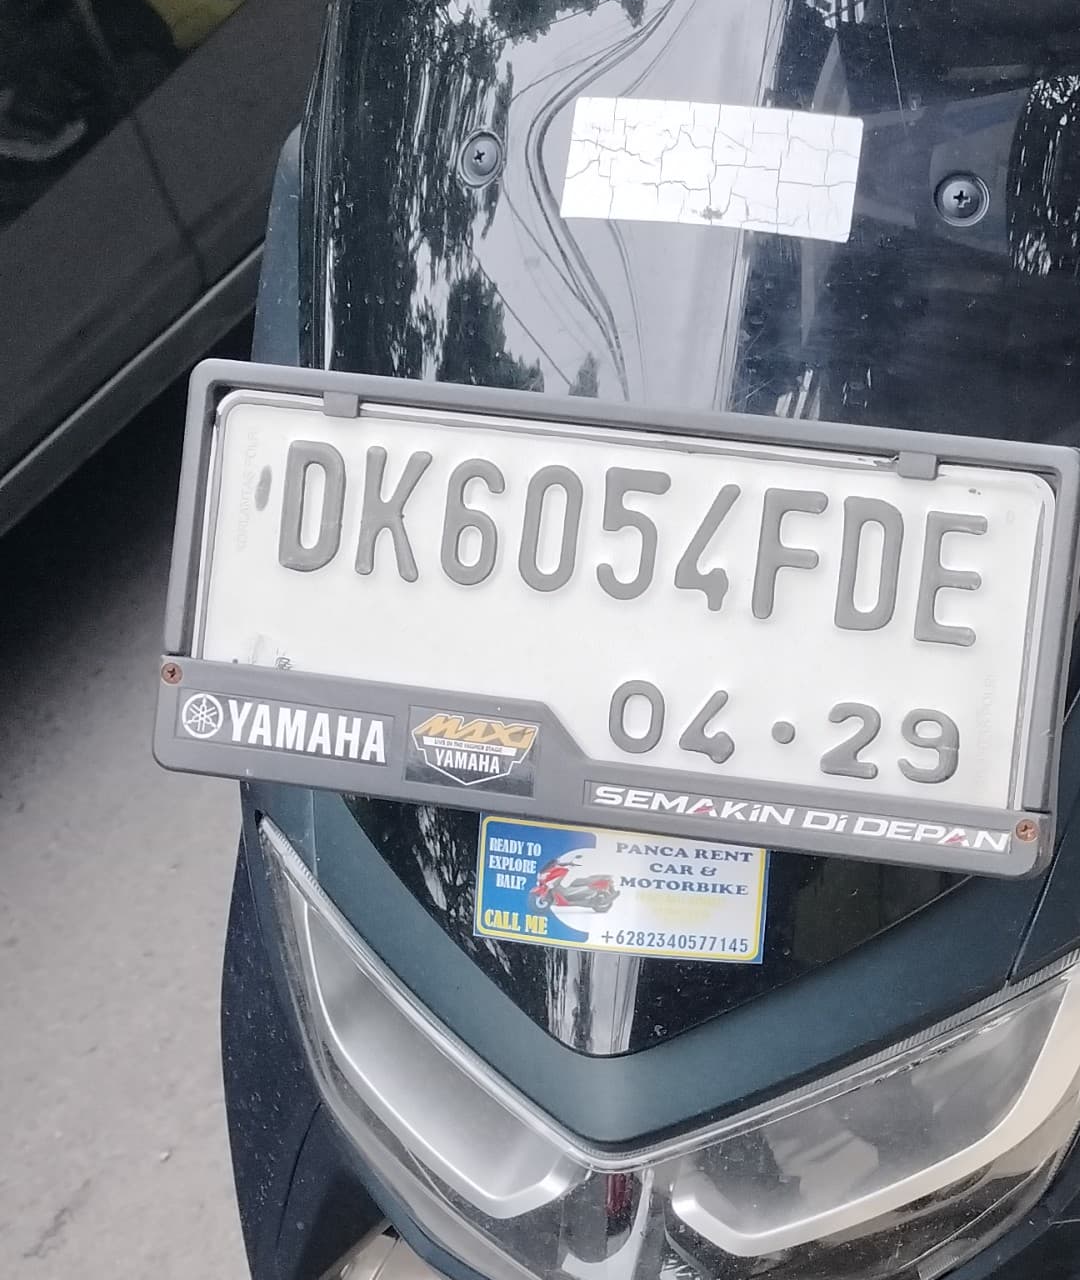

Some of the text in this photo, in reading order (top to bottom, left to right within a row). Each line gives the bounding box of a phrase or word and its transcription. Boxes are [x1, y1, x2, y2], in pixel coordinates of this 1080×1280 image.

[227, 699, 386, 763] YAMAHA
[435, 748, 500, 774] YAMAHA
[852, 818, 1012, 853] DEPAN
[489, 837, 542, 857] READY TO
[616, 842, 754, 864] PANCA RENT
[488, 855, 537, 875] EXPLORE
[649, 862, 717, 877] CAR &
[496, 873, 526, 890] BALI?
[620, 876, 749, 896] MOTORBIKE
[485, 909, 548, 935] CALL ME
[601, 929, 749, 953] +6282340577145
